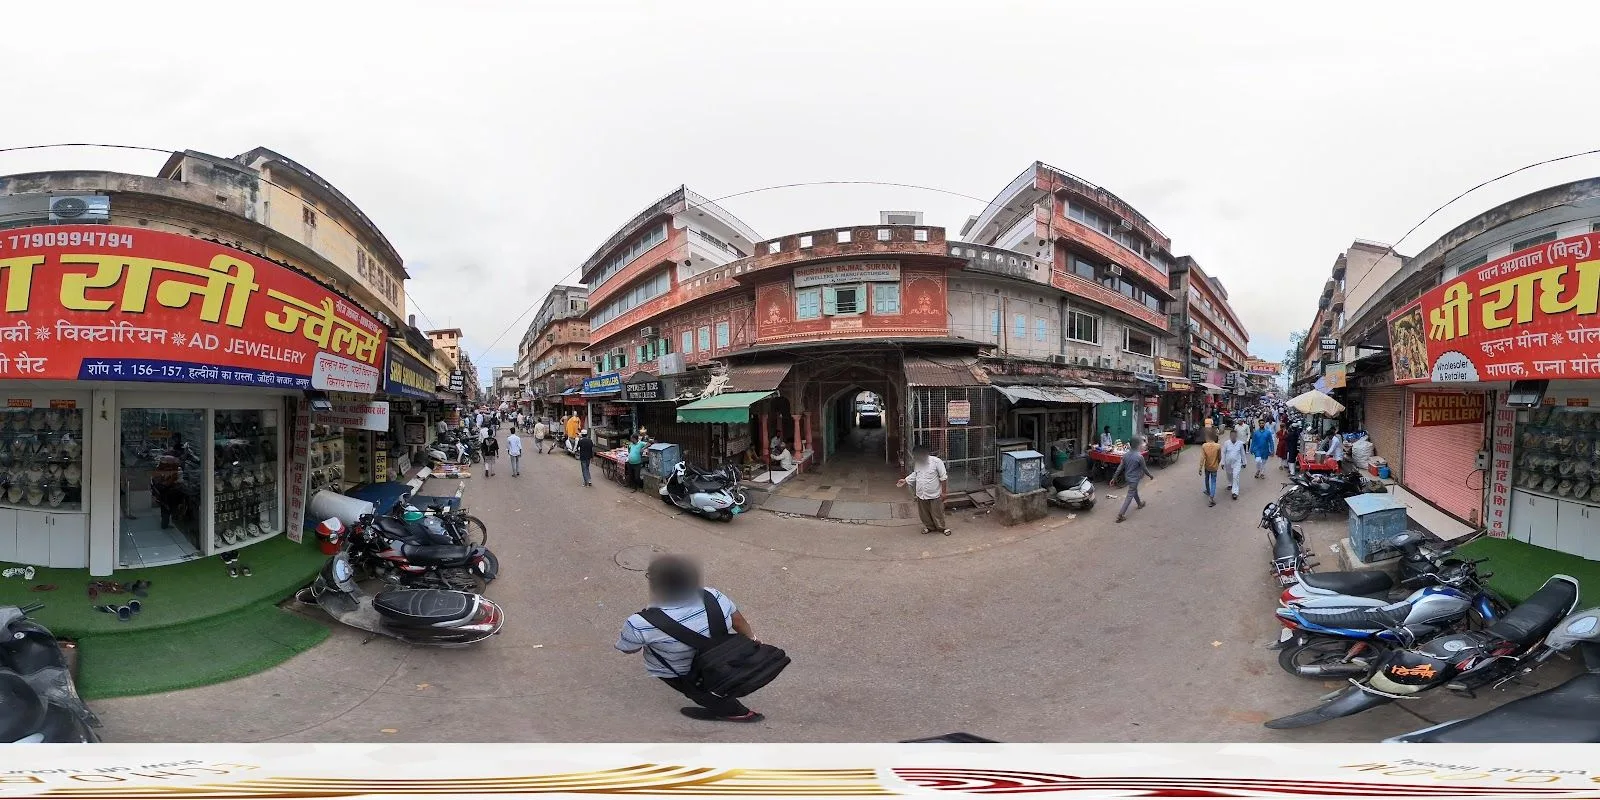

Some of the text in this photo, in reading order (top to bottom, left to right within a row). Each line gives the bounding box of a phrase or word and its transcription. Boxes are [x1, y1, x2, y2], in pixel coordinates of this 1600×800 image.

[8, 232, 133, 249] 7790994794
[865, 263, 898, 271] SURANA
[1478, 265, 1499, 281] पवन
[1500, 249, 1544, 274] अग्रवाल
[59, 253, 259, 328] रानी
[264, 288, 382, 364] ज्वैलर्स
[1429, 281, 1472, 341] श्री
[0, 319, 168, 344] की विक्टोरियन
[188, 332, 306, 364] AD JEWELLERY
[1480, 337, 1513, 357] कुन्दन
[1516, 330, 1548, 349] मीना
[14, 351, 48, 374] सैट
[88, 361, 110, 375] शॉप
[113, 362, 125, 375] नं.
[221, 369, 232, 380] का
[1437, 360, 1468, 372] Wholesaler
[1533, 360, 1566, 375] पन्ना
[1445, 372, 1467, 381] Retailer
[1418, 394, 1483, 408] ARTIFICIAL
[1416, 407, 1482, 425] JEWELLERY
